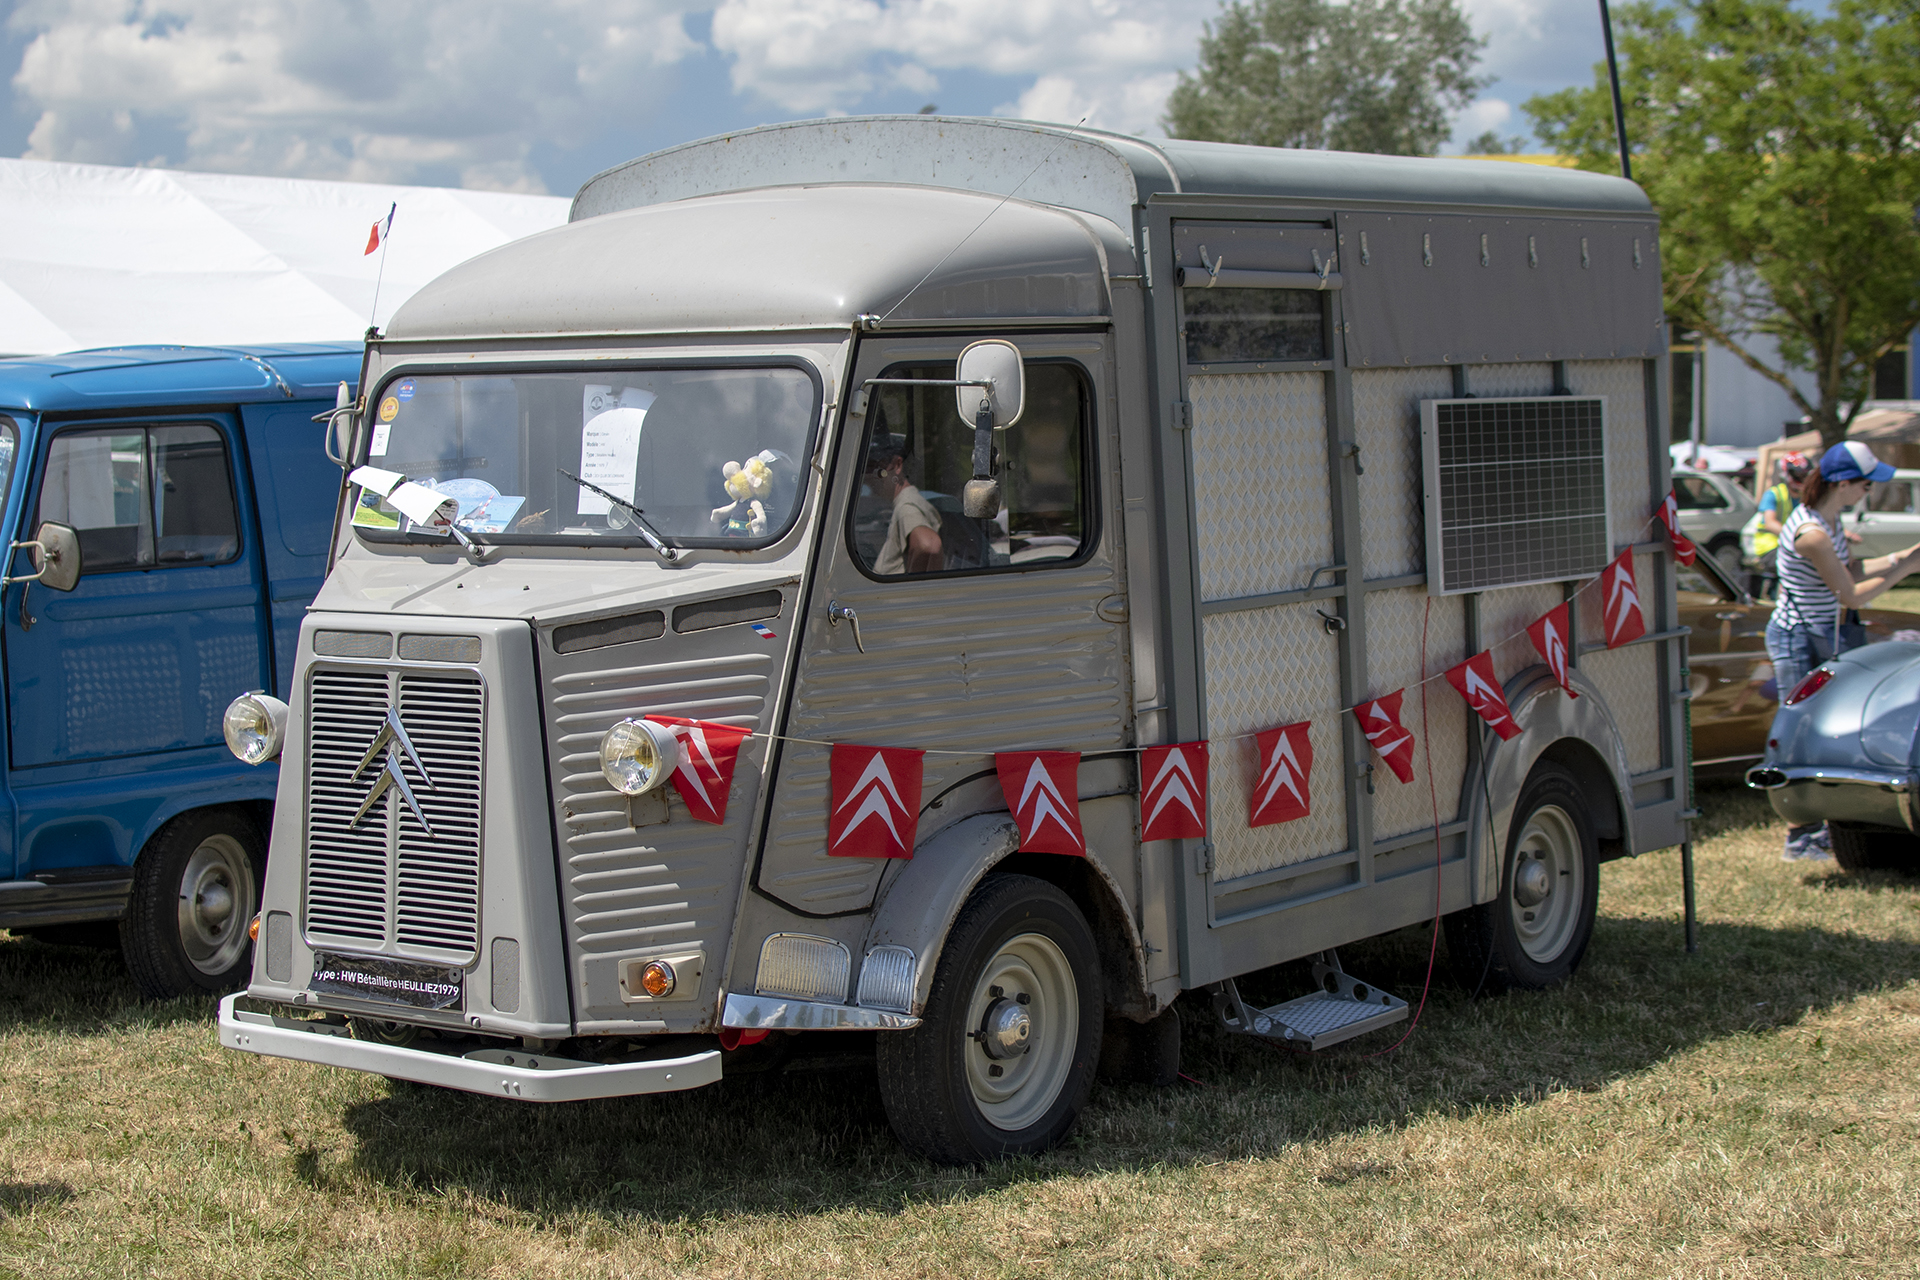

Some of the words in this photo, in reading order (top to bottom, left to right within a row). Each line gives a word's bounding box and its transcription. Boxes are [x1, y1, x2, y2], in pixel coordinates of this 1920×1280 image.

[341, 970, 357, 982] HW
[356, 972, 397, 988] Bétaillère
[397, 979, 439, 994] HEULLIEZ
[438, 983, 460, 996] 1979
